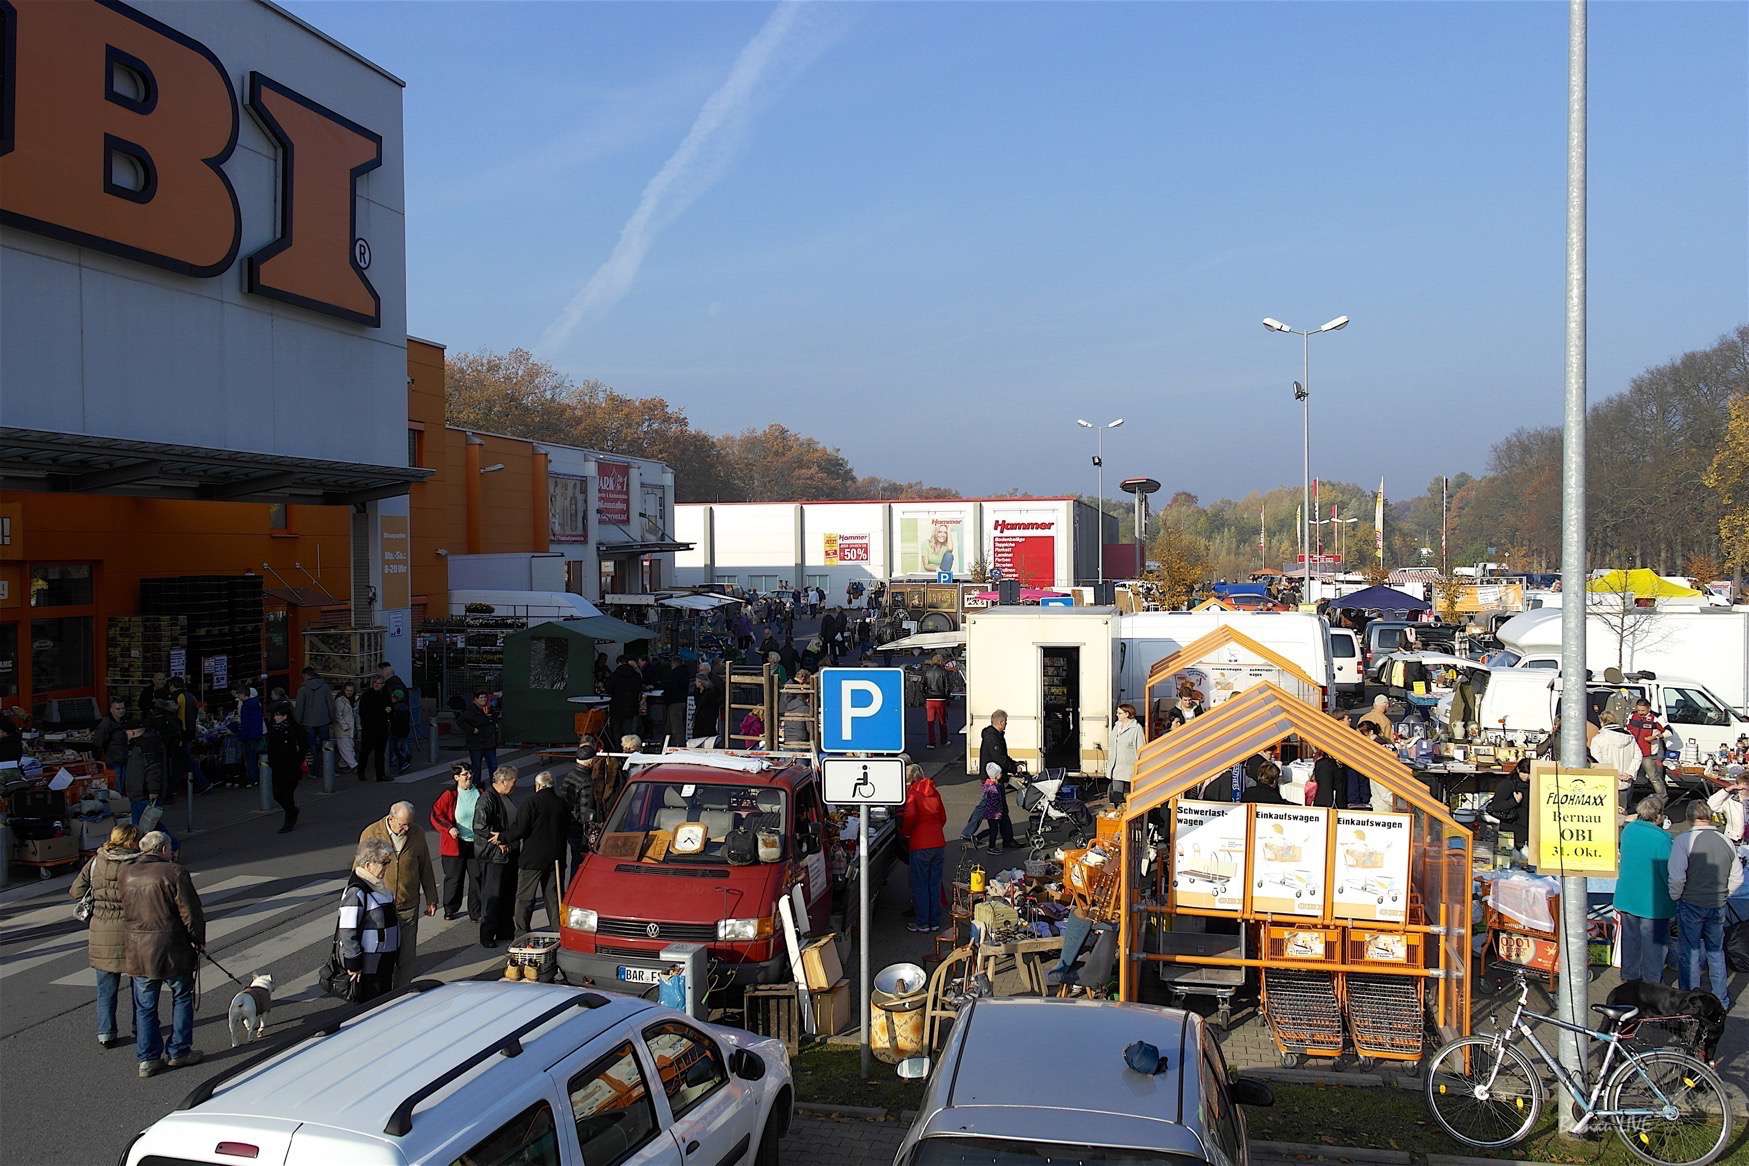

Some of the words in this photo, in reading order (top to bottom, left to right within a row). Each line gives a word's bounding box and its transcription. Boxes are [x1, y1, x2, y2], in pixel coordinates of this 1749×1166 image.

[994, 519, 1055, 533] Hammer
[844, 548, 868, 560] 50%
[940, 573, 949, 583] P
[841, 680, 883, 741] P
[1546, 792, 1607, 807] FLOHMAXX
[1177, 806, 1229, 818] Schwerlast-
[1256, 810, 1320, 823] Einkaufswagen
[1552, 811, 1601, 823] Bernau
[1177, 817, 1204, 827] wagen
[1337, 816, 1403, 829] Einkaufswagen
[1560, 828, 1593, 842] OBI
[1574, 846, 1603, 858] Okt.
[626, 969, 644, 981] BAR
